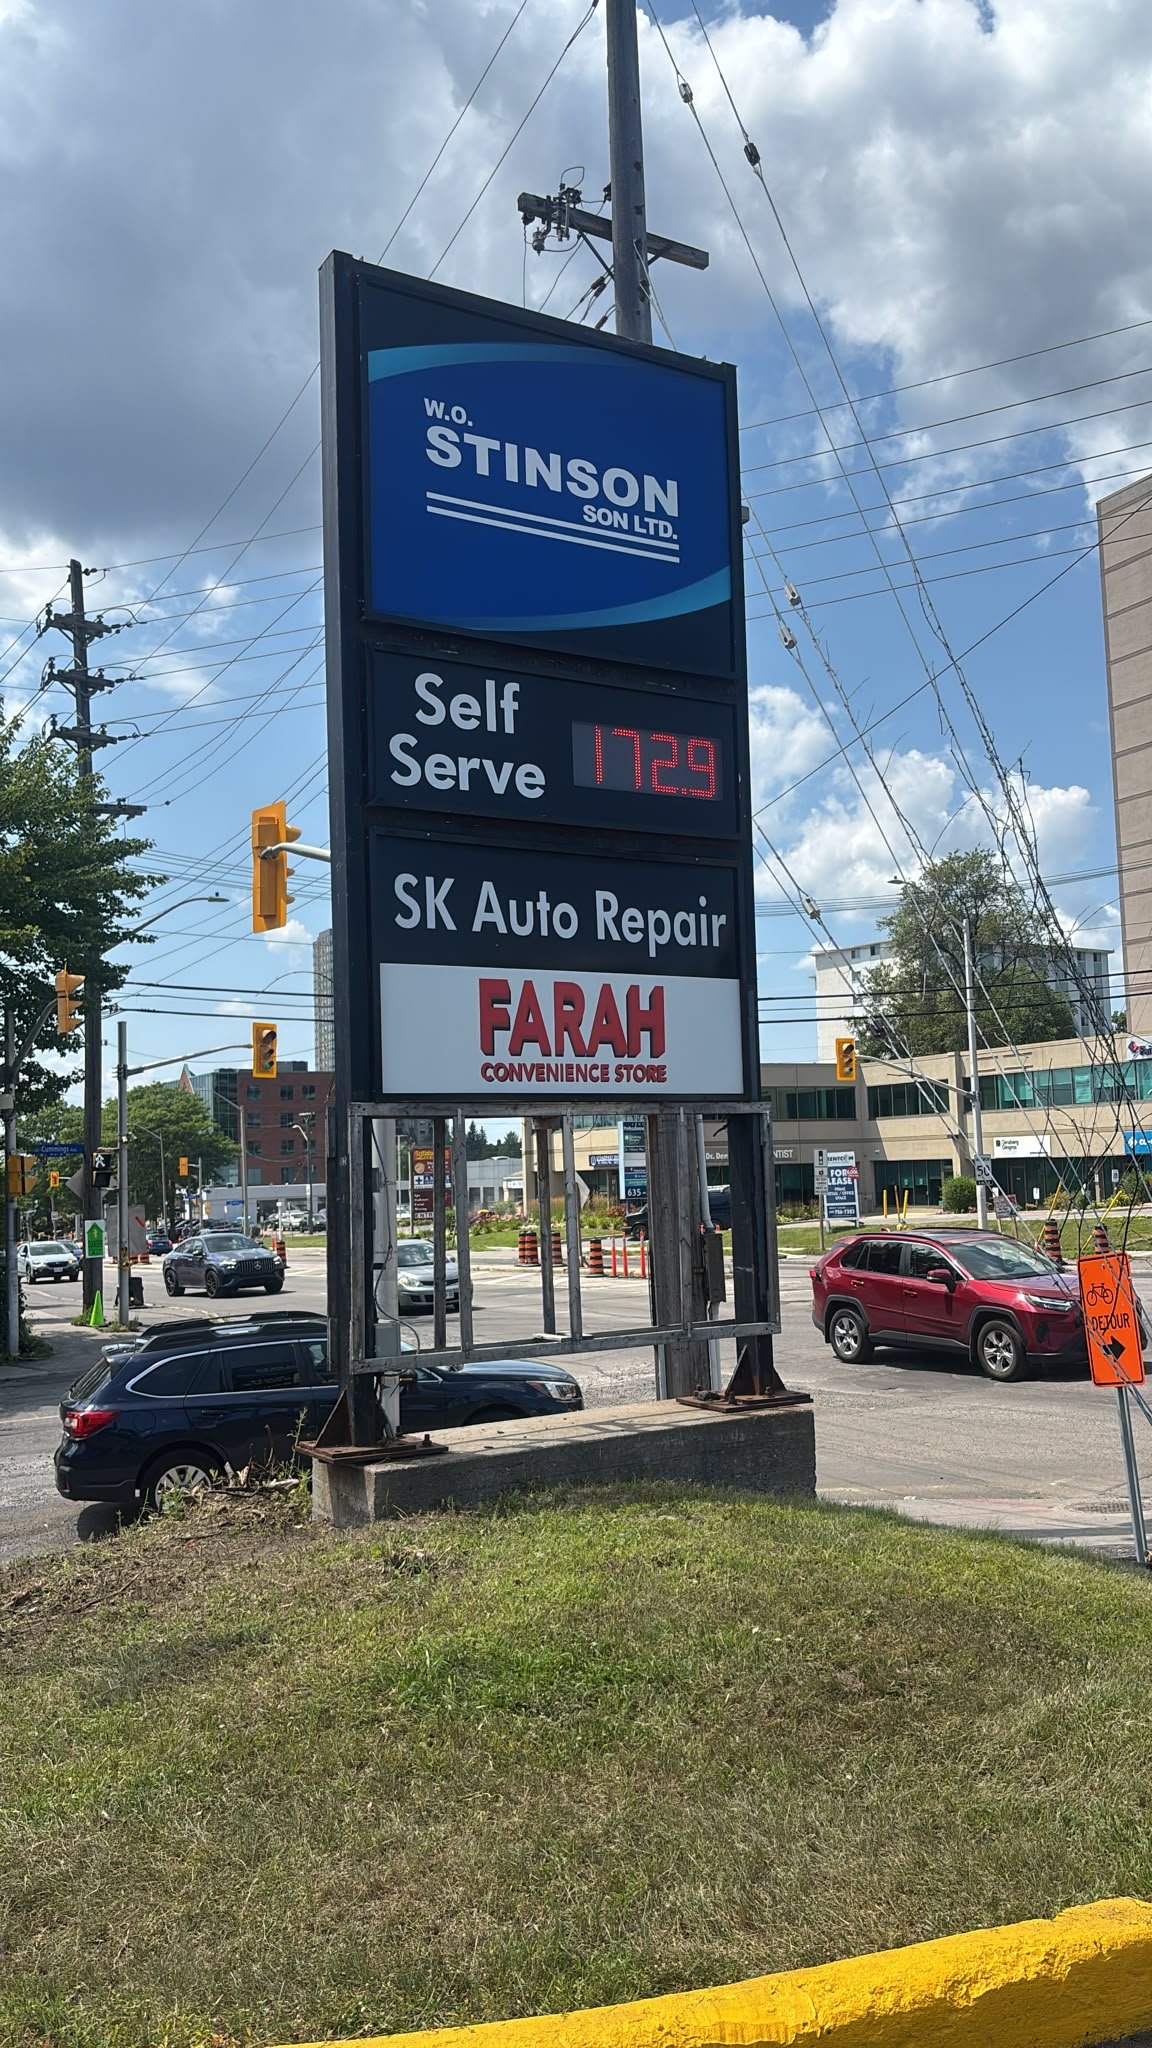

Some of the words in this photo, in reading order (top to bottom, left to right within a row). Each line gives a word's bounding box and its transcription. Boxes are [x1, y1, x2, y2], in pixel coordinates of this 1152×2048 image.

[424, 397, 473, 427] W.O.
[426, 425, 680, 518] STINSON
[582, 504, 629, 531] SON
[633, 517, 678, 540] LTD.
[414, 672, 521, 734] Self
[389, 733, 546, 799] Serve
[394, 873, 457, 931] SK
[472, 880, 579, 939] Auto
[595, 890, 727, 957] Repair
[478, 978, 667, 1059] FARAH
[480, 1062, 610, 1083] CONVENIENCE
[614, 1064, 667, 1083] STORE
[41, 1145, 69, 1154] Cummings
[705, 1152, 715, 1160] Dr.
[827, 1177, 853, 1185] LEASE
[830, 1169, 848, 1177] FOR
[976, 1164, 991, 1177] 50
[1091, 1313, 1131, 1331] DETOUR
